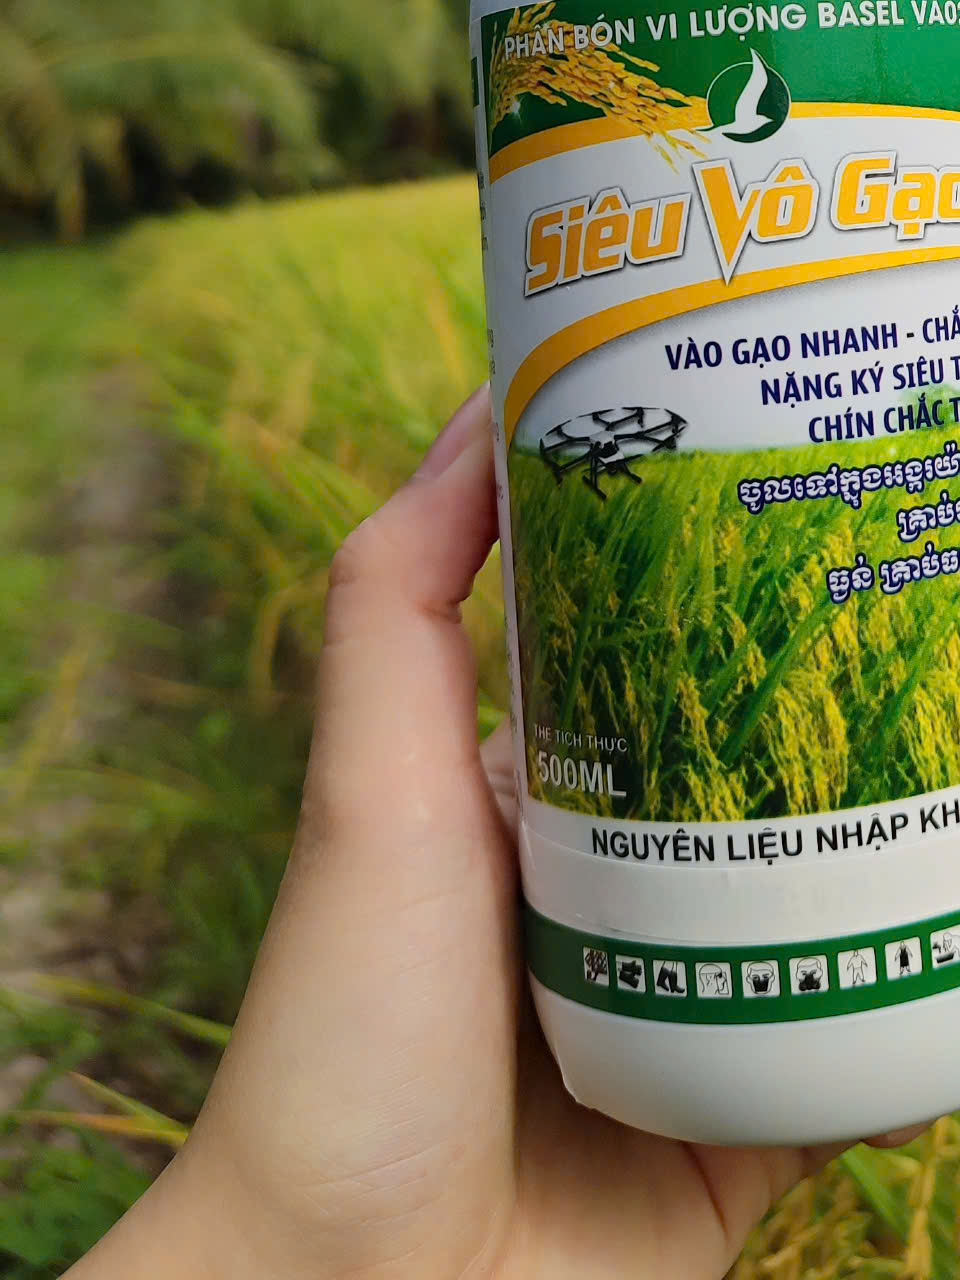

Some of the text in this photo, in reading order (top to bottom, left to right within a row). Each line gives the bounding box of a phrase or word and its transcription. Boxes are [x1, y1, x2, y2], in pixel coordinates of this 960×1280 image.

[504, 24, 565, 61] PHÂN
[574, 13, 635, 50] BÓN
[646, 14, 677, 42] VI
[690, 1, 806, 43] LƯỢNG
[818, 0, 904, 29] BASEL
[524, 186, 691, 297] Siêu
[692, 157, 820, 285] Vô
[665, 336, 723, 370] VÀO
[732, 334, 791, 369] GẠO
[800, 322, 898, 359] NHANH
[761, 371, 842, 408] NẶNG
[851, 361, 884, 395] KÝ
[893, 355, 944, 391] SIÊU
[808, 407, 875, 443] CHÍN
[883, 394, 944, 433] CHẮC
[585, 734, 628, 755] THỰC
[538, 749, 627, 797] 500ML
[591, 826, 715, 862] NGUYÊN
[727, 826, 803, 865] LIỆU
[816, 812, 908, 851] NHẬP
